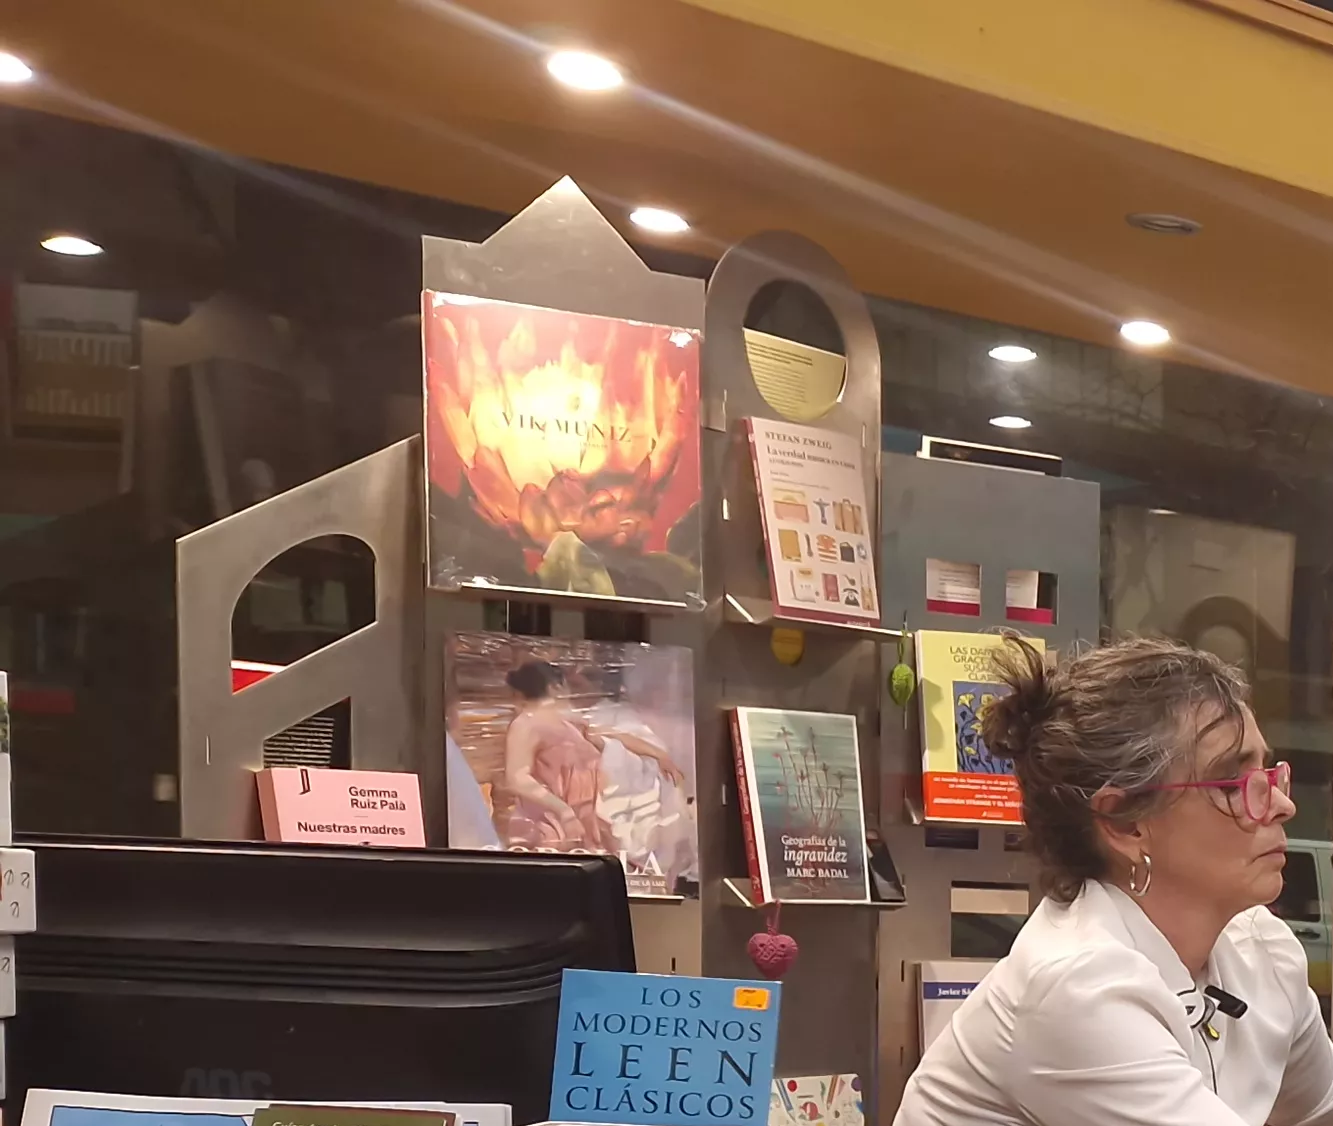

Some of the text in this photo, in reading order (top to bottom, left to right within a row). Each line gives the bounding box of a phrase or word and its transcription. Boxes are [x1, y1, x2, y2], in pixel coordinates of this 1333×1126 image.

[555, 418, 631, 442] MUNIZ
[765, 431, 800, 444] STEFAN
[348, 785, 399, 799] Gemma
[350, 797, 378, 810] Ruiz
[297, 820, 406, 836] Nuestras madres
[781, 834, 846, 849] Geografías de la
[783, 847, 848, 864] ingravidez
[786, 866, 849, 879] MARC BADAL
[640, 986, 701, 1009] LOS
[573, 1012, 762, 1042] MODERNOS
[570, 1041, 758, 1086] LEEN
[565, 1083, 755, 1119] CLÁSICOS
